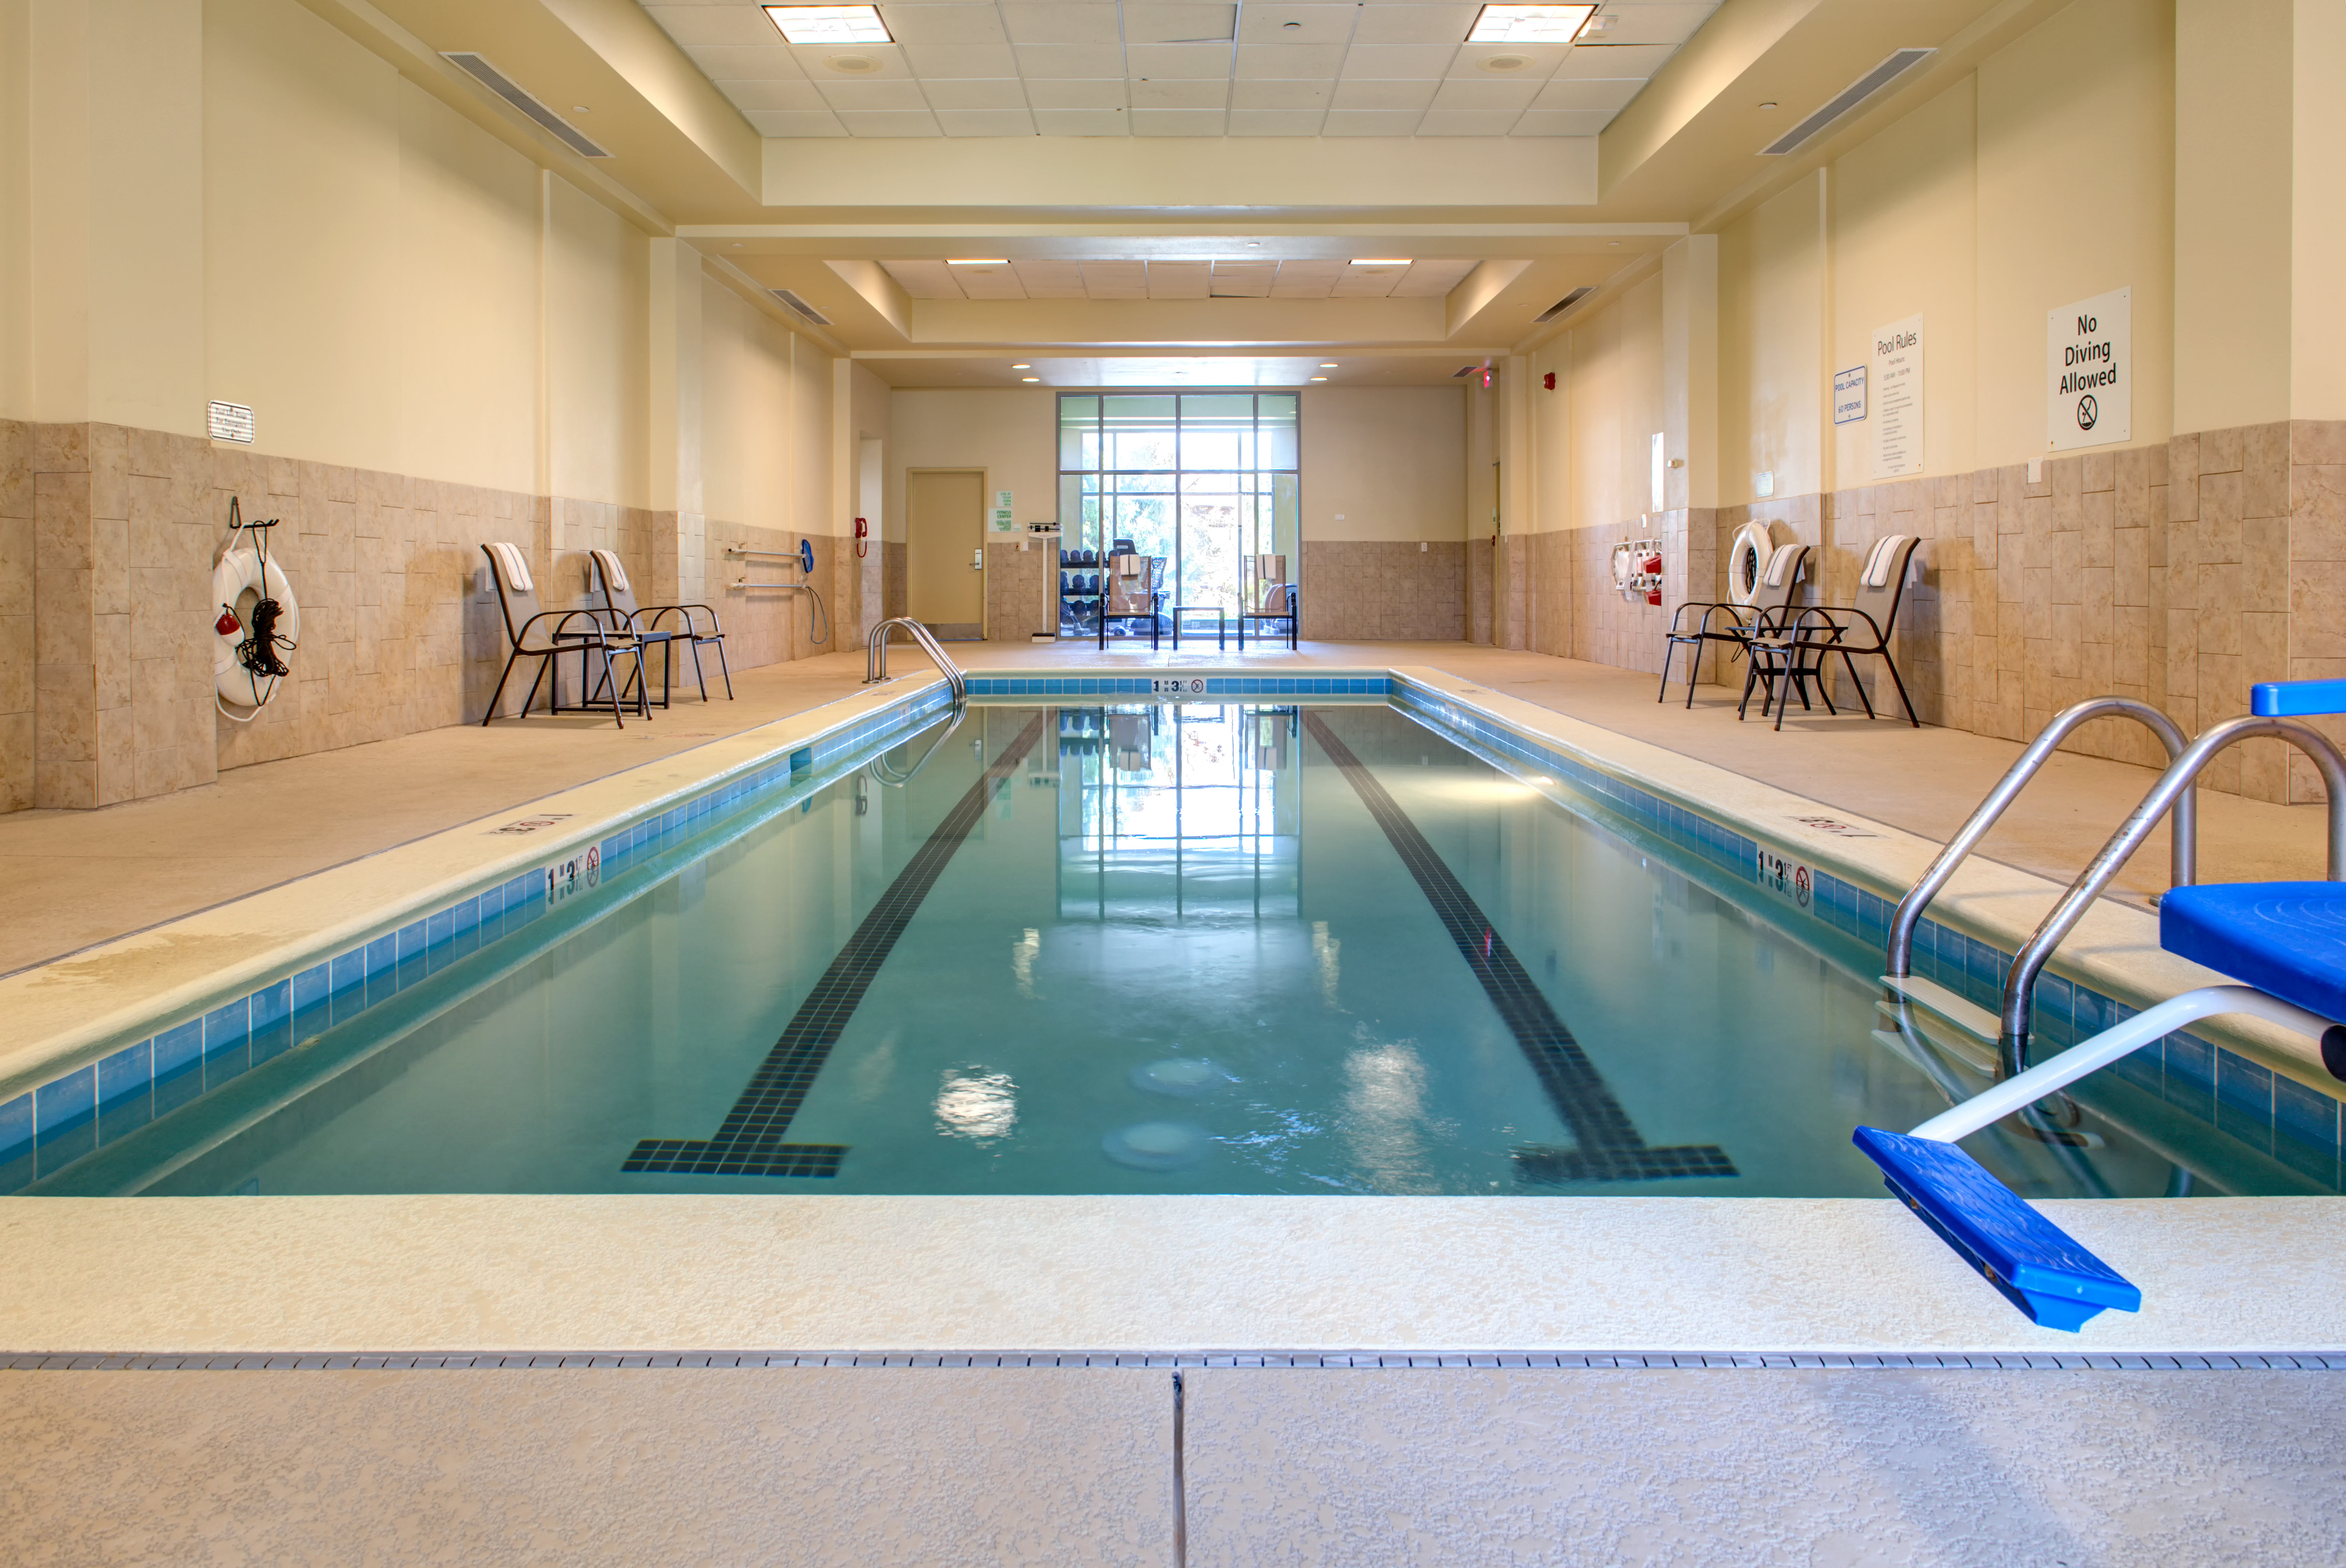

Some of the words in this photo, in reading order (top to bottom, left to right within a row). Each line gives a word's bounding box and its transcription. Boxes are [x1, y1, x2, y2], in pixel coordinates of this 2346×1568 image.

[2078, 314, 2097, 336] No
[1878, 336, 1894, 356] Pool
[1896, 331, 1917, 350] Rules
[2065, 341, 2111, 367] Diving
[1835, 383, 1845, 392] POOL
[1846, 376, 1864, 389] CAPACITY
[2059, 362, 2117, 395] Allowed
[1844, 401, 1861, 412] PERSONS
[1759, 850, 1764, 871] 1
[1768, 854, 1772, 868] M
[548, 868, 554, 891] 1
[560, 864, 564, 877] M
